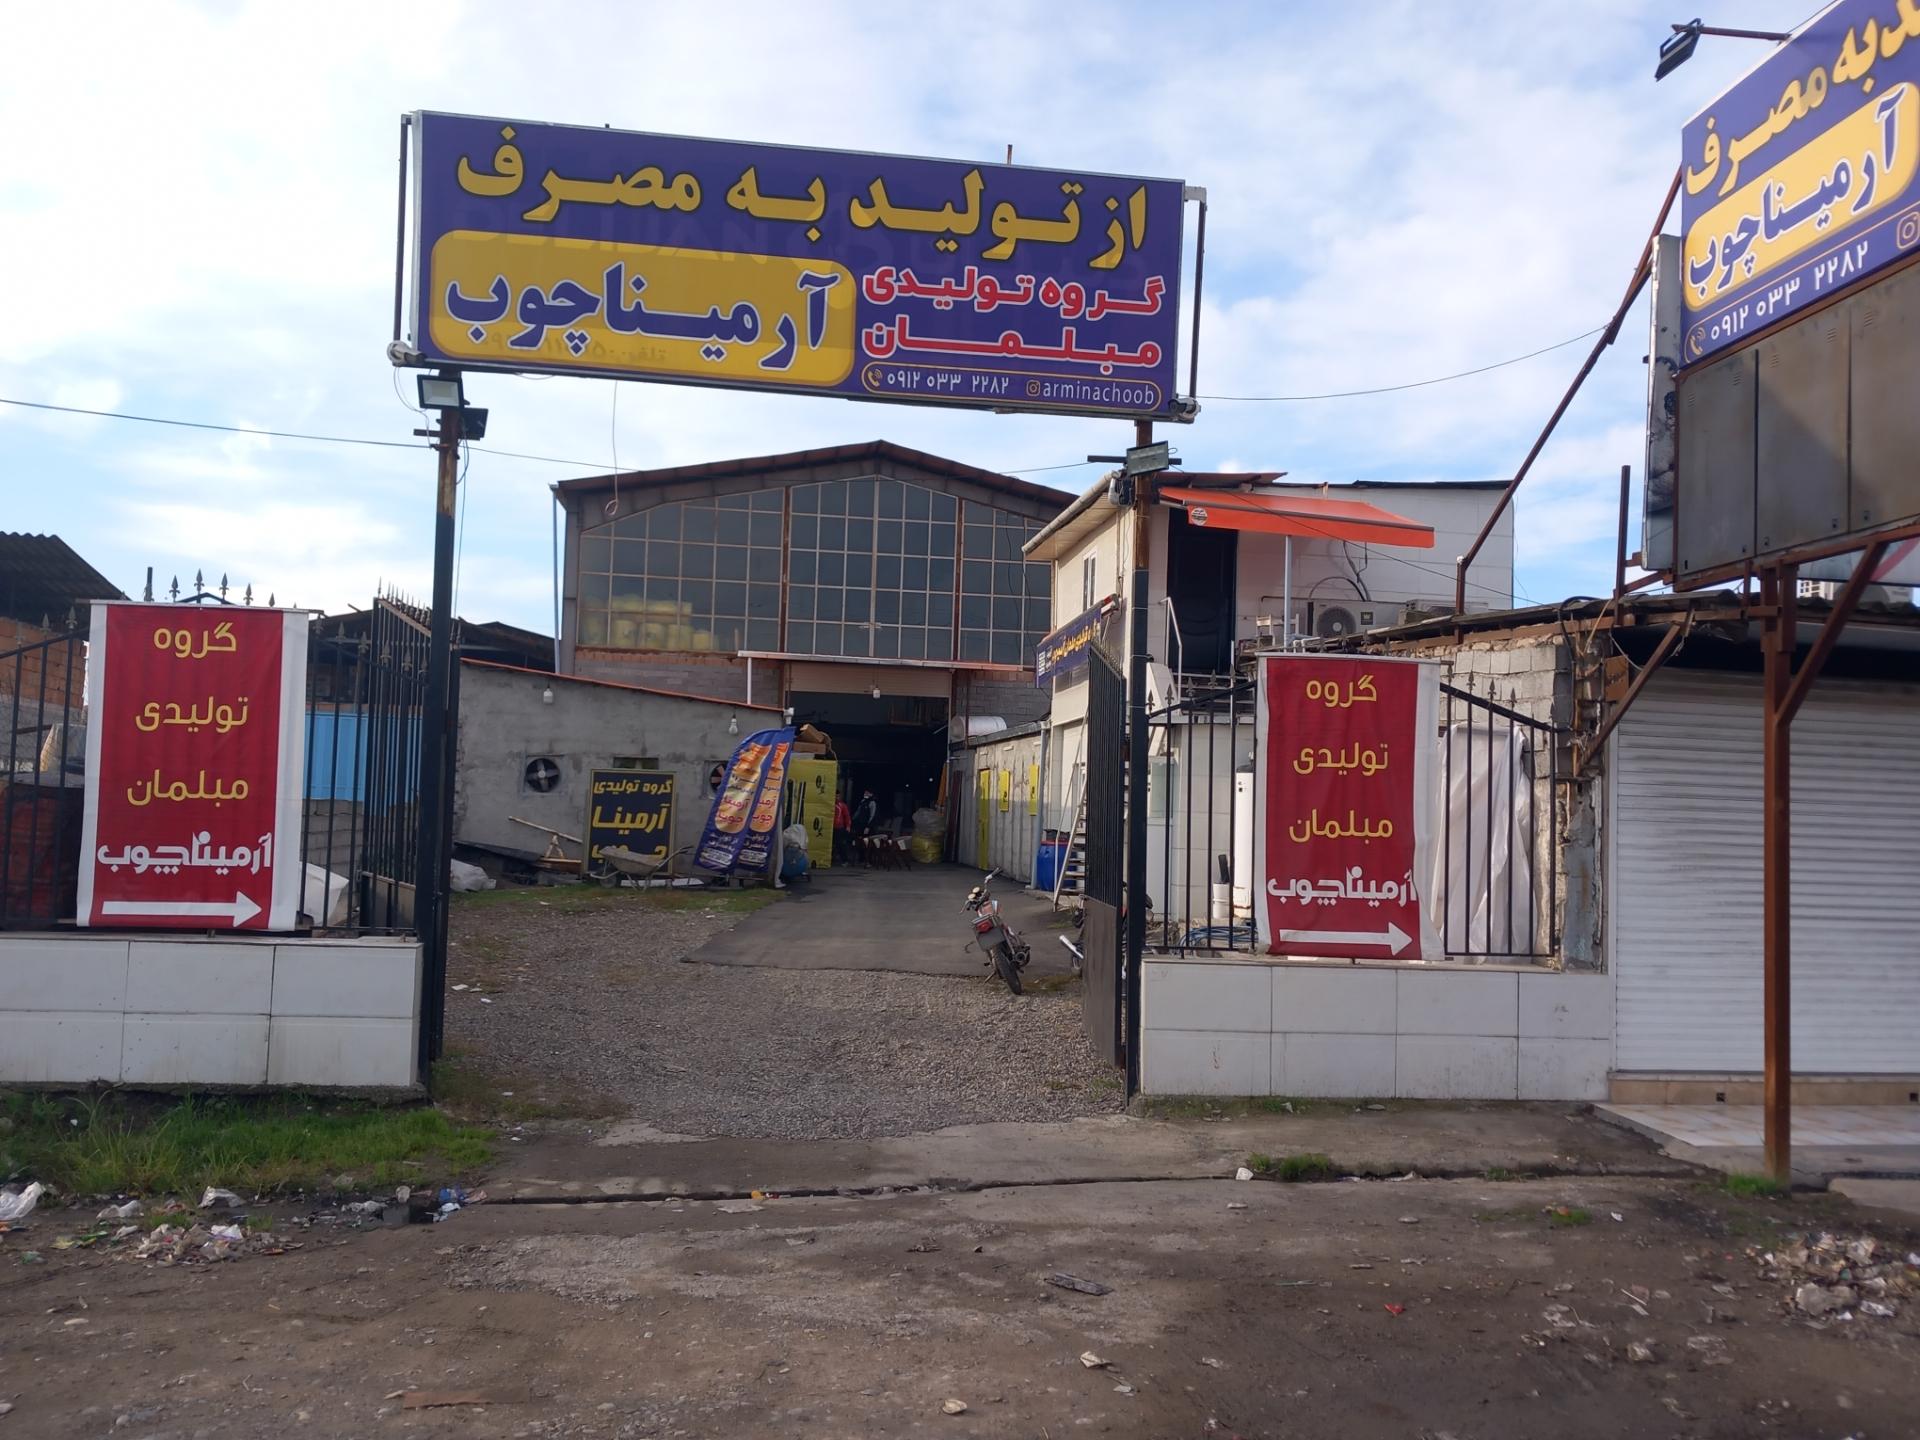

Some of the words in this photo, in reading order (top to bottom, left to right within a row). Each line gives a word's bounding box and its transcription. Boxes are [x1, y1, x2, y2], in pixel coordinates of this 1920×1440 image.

[1832, 17, 1877, 94] به
[1686, 66, 1828, 197] مصرف
[456, 125, 702, 222] مصرف
[725, 165, 827, 243] به
[849, 168, 1081, 261] تولید
[1088, 184, 1148, 269] از
[862, 265, 1035, 312] تولیدی
[1038, 275, 1165, 320] گروه
[862, 314, 1163, 376] مبلمان
[1043, 379, 1155, 406] arminachoob
[153, 622, 237, 659] گروه
[1306, 675, 1378, 708] گروه
[135, 696, 249, 733] تولیدی
[1292, 742, 1389, 776] تولیدی
[127, 769, 249, 808] مبلمان
[593, 779, 640, 795] تولیدی
[643, 779, 673, 795] گروه
[592, 803, 671, 835] آرمینا
[1288, 809, 1393, 844] مبلمان
